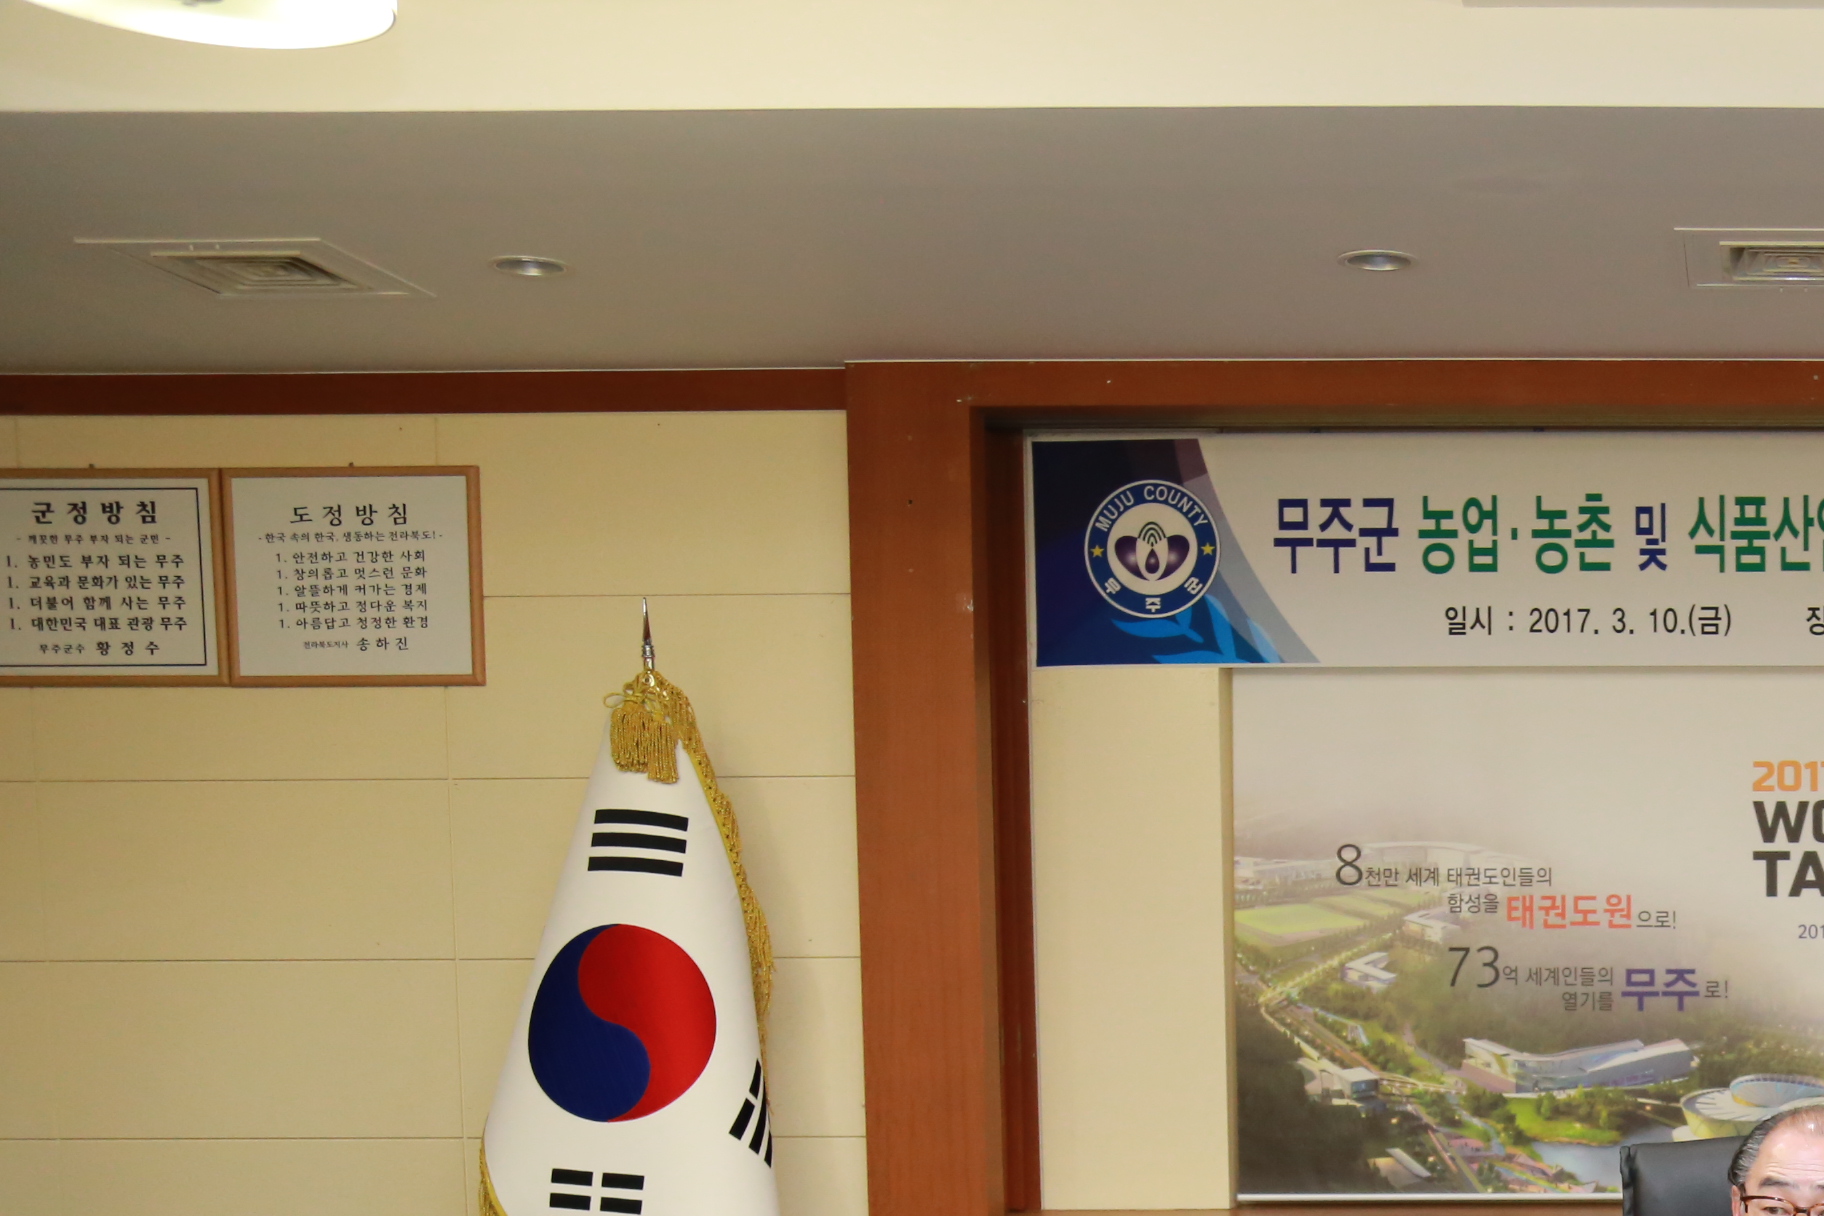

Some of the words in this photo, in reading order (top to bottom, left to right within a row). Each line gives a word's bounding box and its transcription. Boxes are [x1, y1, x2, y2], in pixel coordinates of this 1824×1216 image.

[1095, 491, 1134, 531] MUJU
[1144, 486, 1208, 527] COUNTY
[90, 535, 108, 544] 부자
[115, 534, 133, 544] 되는
[290, 532, 309, 542] 속의
[343, 531, 385, 542] 생동하는
[1273, 498, 1399, 574] 무주군
[1635, 503, 1667, 571] 및
[28, 555, 72, 569] 농민도
[81, 555, 109, 568] 부자
[118, 555, 146, 568] 되는
[156, 555, 183, 568] 무주
[293, 552, 347, 564] 안전하고
[354, 551, 393, 563] 건강한
[401, 550, 424, 562] 사회
[294, 568, 348, 580] 창의롭고
[355, 567, 394, 579] 멋스런
[401, 567, 427, 579] 문화
[30, 576, 70, 589] 교육과
[77, 575, 118, 589] 문화가
[125, 575, 152, 589] 있는
[158, 576, 184, 589] 무주
[295, 584, 347, 597] 알뜰하게
[355, 584, 395, 595] 커가는
[402, 583, 426, 595] 경제
[30, 596, 73, 610] 더불어
[83, 596, 111, 610] 함께
[121, 596, 148, 610] 사는
[158, 596, 185, 610] 무주
[296, 601, 349, 613] 따뜻하고
[356, 600, 396, 612] 정다운
[403, 600, 427, 611] 복지
[31, 617, 86, 631] 대한민국
[94, 617, 121, 631] 대표
[127, 617, 154, 631] 관광
[160, 617, 187, 630] 무주
[296, 617, 350, 630] 아름답고
[357, 617, 397, 629] 청정한
[403, 616, 427, 628] 환경
[1445, 606, 1491, 635] 일시
[40, 644, 84, 654] 무주군수
[1335, 844, 1399, 887] 8천만
[1406, 866, 1440, 887] 세계
[1447, 866, 1551, 887] 태권도인들의
[1448, 893, 1499, 913] 함성을
[1448, 945, 1518, 988] 73억
[1527, 966, 1612, 986] 세계인들의
[1563, 991, 1613, 1011] 열기를
